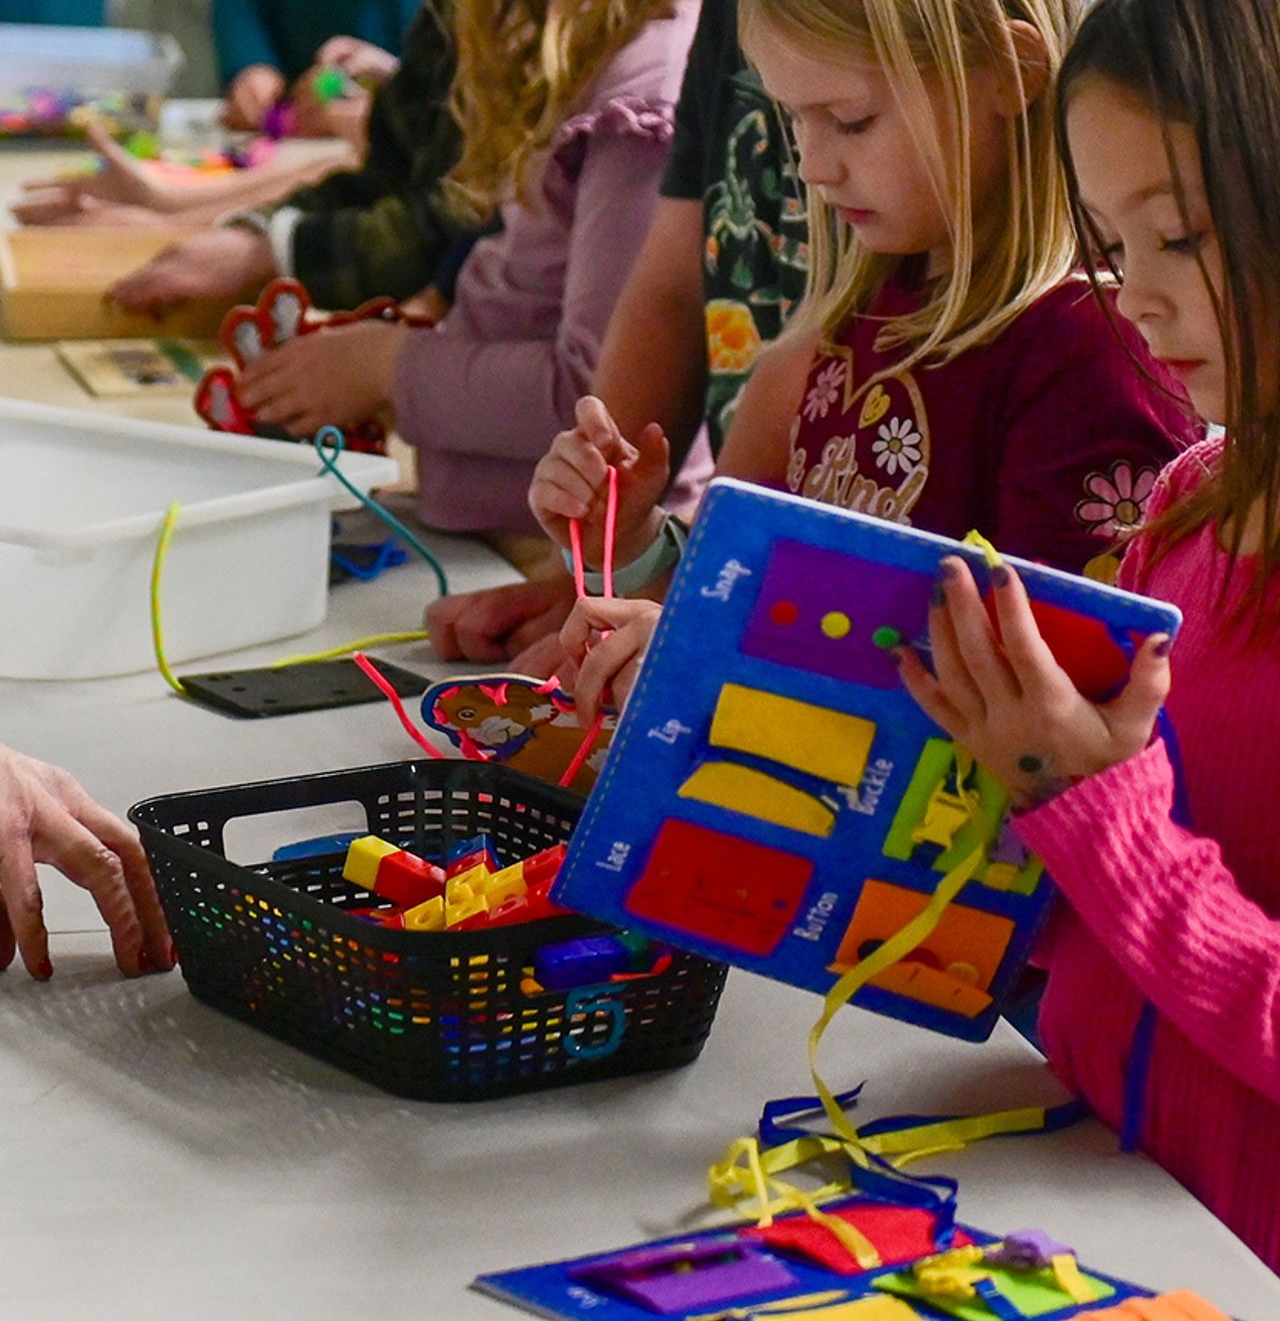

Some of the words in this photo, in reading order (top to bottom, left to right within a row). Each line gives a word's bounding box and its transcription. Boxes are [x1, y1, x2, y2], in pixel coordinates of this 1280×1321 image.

[700, 558, 752, 602] Snap
[647, 718, 692, 745] Zip
[852, 758, 895, 816] Buckle
[595, 841, 631, 872] Lace
[792, 892, 839, 942] Button
